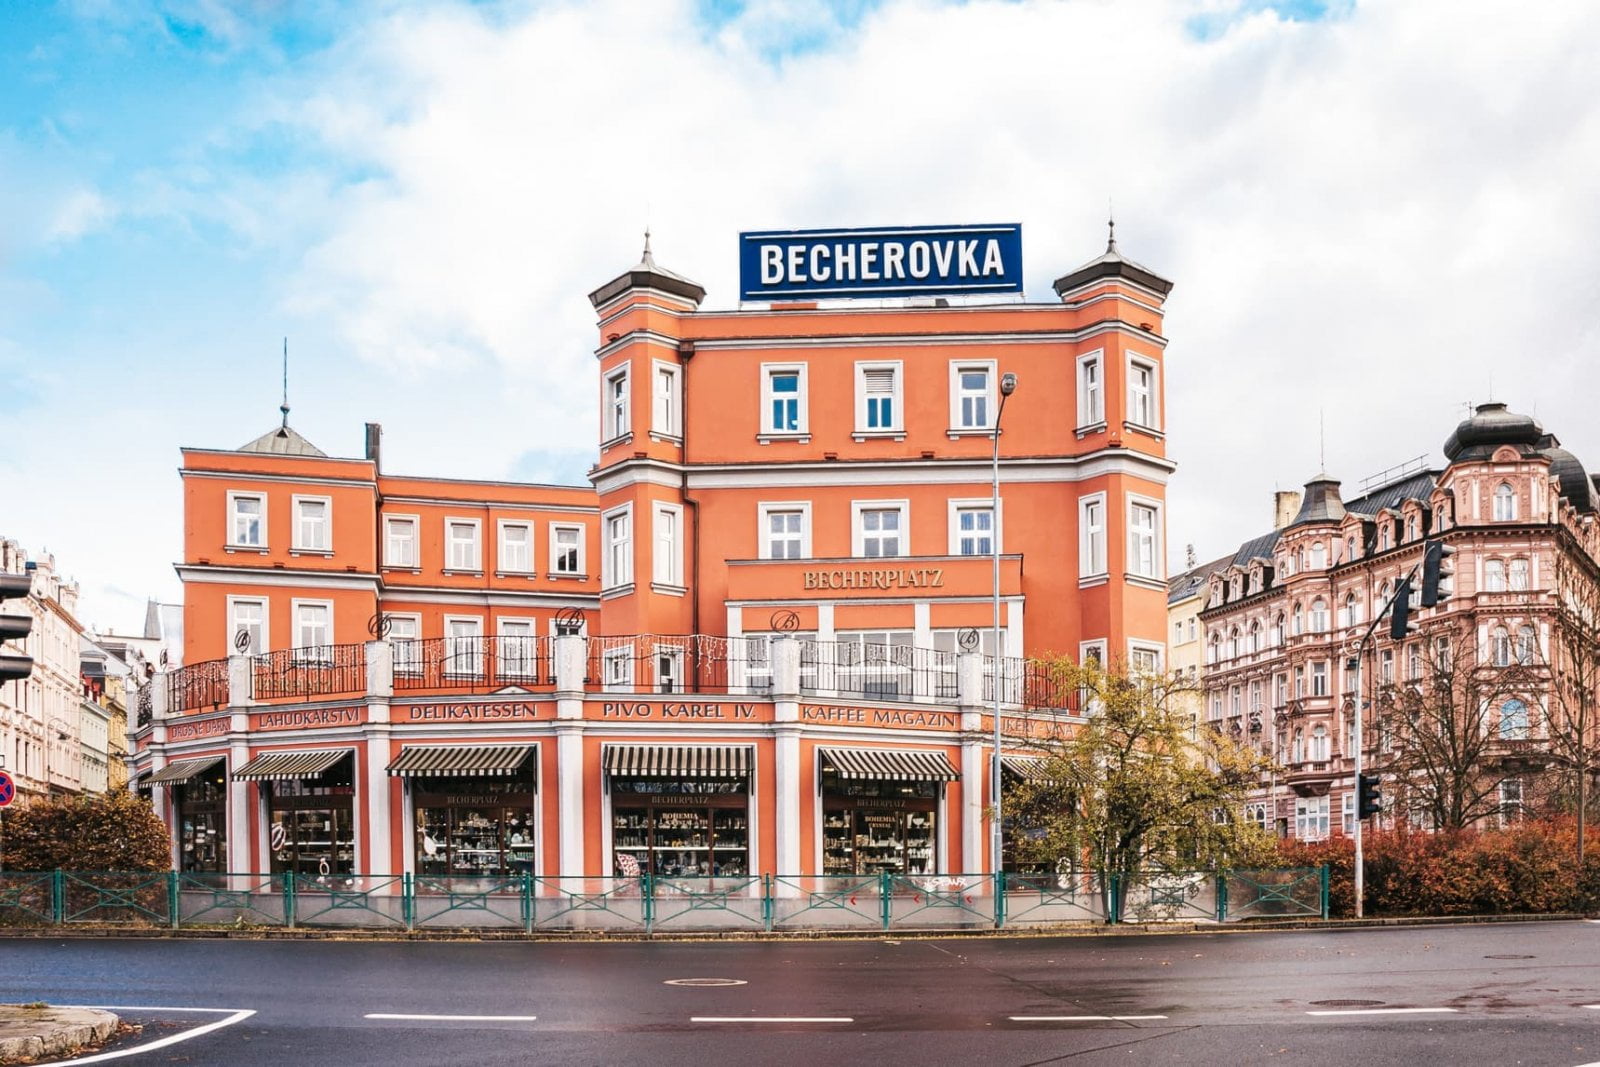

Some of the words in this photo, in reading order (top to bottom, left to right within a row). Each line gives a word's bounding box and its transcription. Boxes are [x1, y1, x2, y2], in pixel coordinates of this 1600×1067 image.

[760, 239, 1005, 284] BECHEROVKA
[804, 569, 944, 590] BECHERPLATZ
[410, 704, 537, 720] DELIKATESSEN
[603, 703, 652, 717] PIVO
[662, 704, 726, 719] KAREL
[735, 704, 757, 719] IV.
[802, 706, 865, 722] KAFFEE
[873, 710, 956, 728] MAGAZIN
[662, 812, 699, 820] BOHEMIA
